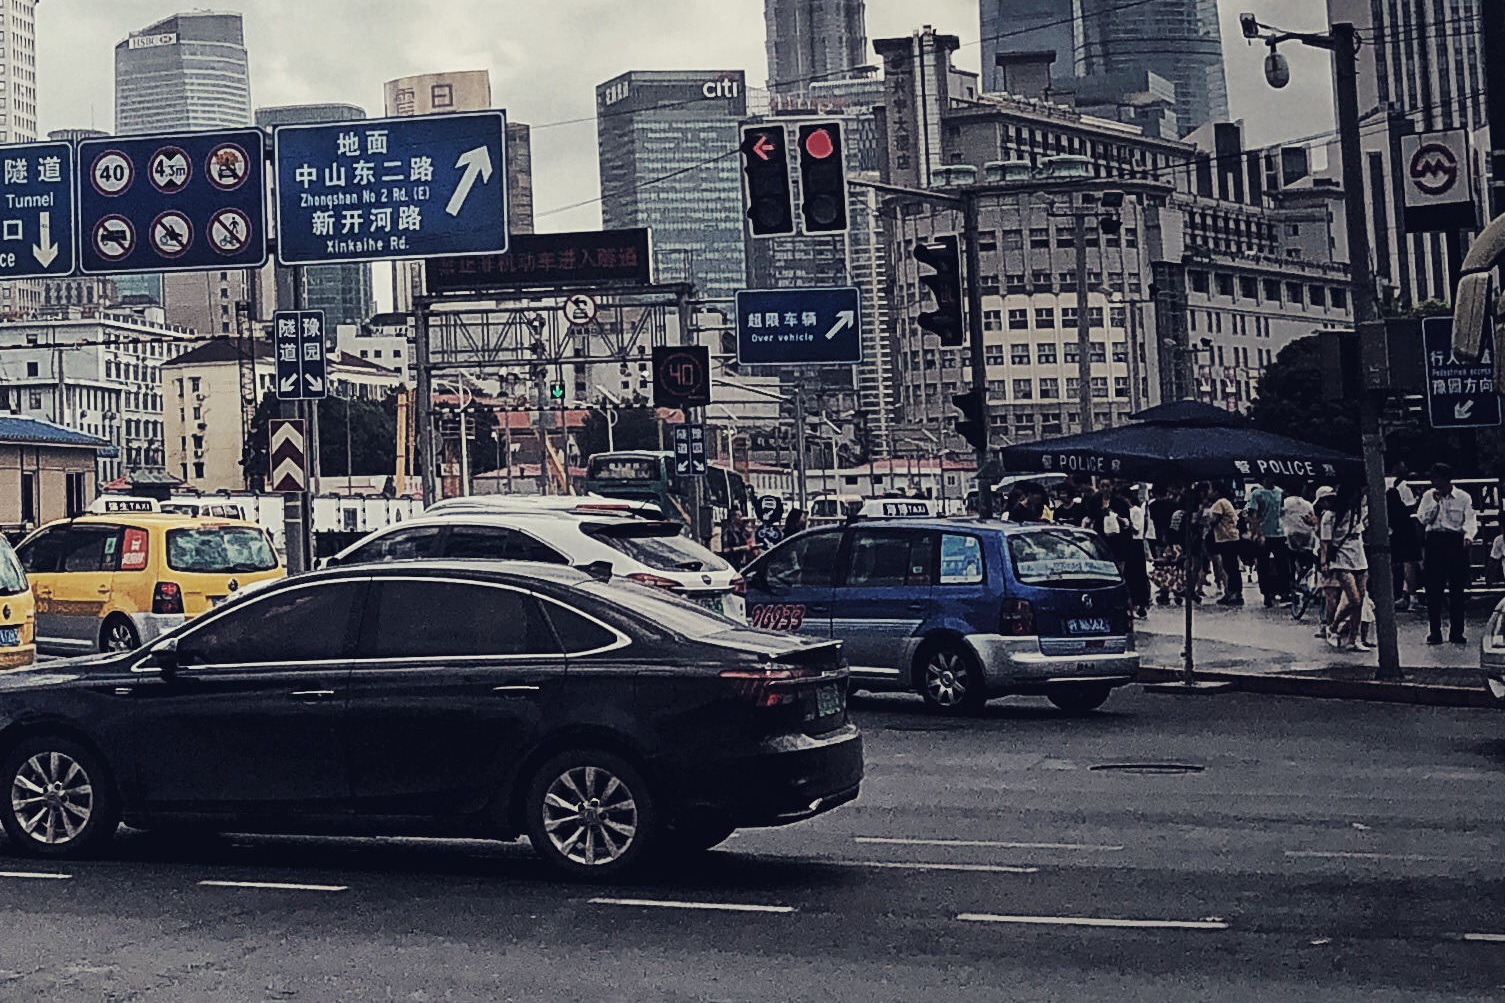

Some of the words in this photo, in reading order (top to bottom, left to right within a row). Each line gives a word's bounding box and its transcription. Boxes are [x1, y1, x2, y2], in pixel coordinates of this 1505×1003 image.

[337, 129, 389, 157] 地面
[99, 164, 125, 182] 40
[154, 158, 186, 178] 4.3m
[295, 155, 435, 189] 中山东二路
[5, 191, 54, 209] Tunnel
[300, 192, 358, 210] Zhongshan
[381, 188, 388, 203] 2
[393, 186, 409, 202] Rd.
[413, 186, 430, 201] (E)
[312, 204, 422, 236] 新开河路
[327, 237, 384, 254] Xinkaihe
[390, 234, 410, 250] Rd.
[278, 319, 297, 361] 隧道
[302, 318, 321, 361] 豫园
[669, 364, 694, 385] 40
[1059, 455, 1105, 472] POLICE
[1256, 459, 1316, 476] POLICE
[130, 502, 150, 510] TAXI
